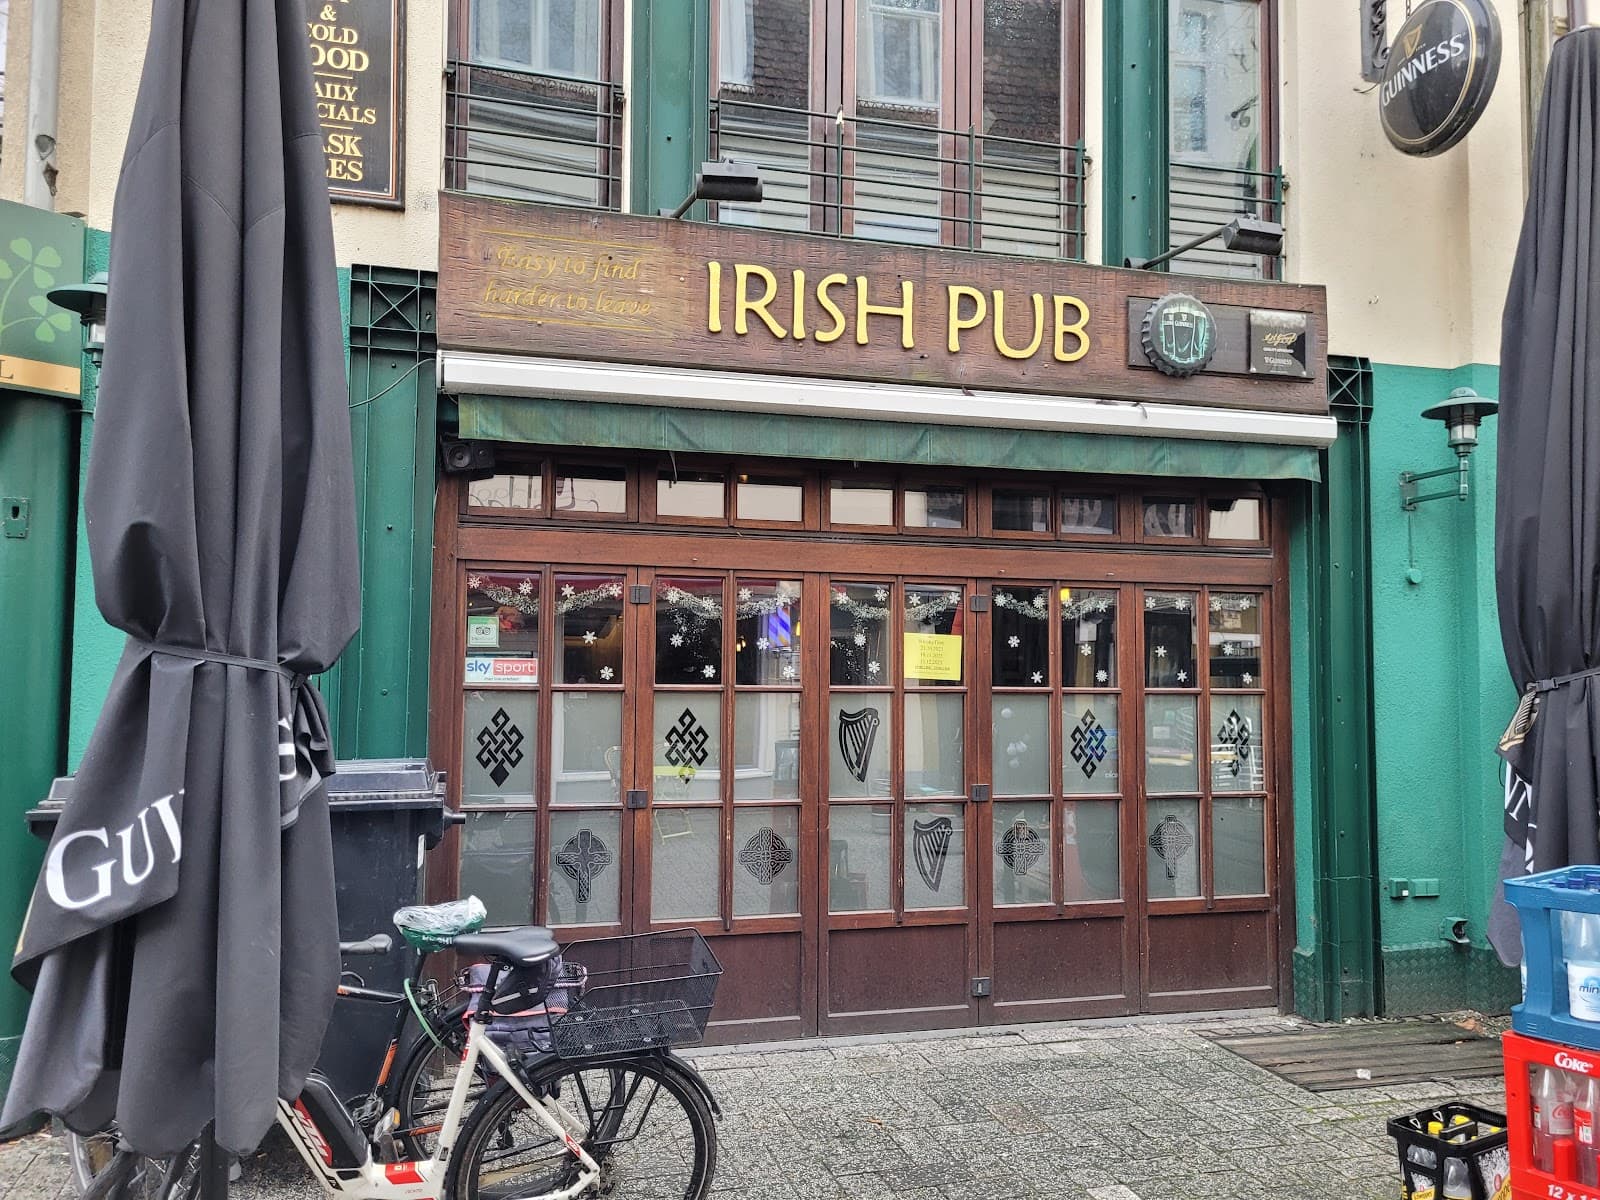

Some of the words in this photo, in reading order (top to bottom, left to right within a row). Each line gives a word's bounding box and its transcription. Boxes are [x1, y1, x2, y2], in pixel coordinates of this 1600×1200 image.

[320, 5, 337, 21] &
[310, 45, 369, 72] OOD
[1382, 33, 1465, 106] GUINNESS
[315, 80, 358, 102] AILY
[316, 103, 377, 125] CIALS
[323, 133, 363, 157] SK
[326, 158, 363, 182] ES
[497, 244, 557, 279] Easy
[563, 256, 586, 275] to
[592, 255, 643, 284] find
[483, 279, 559, 307] harder
[567, 293, 588, 311] to
[595, 290, 653, 317] leave
[706, 261, 915, 349] IRISH
[946, 284, 1091, 363] PUB
[466, 660, 492, 675] sky
[495, 663, 534, 674] sport
[1547, 1183, 1564, 1199] 12
